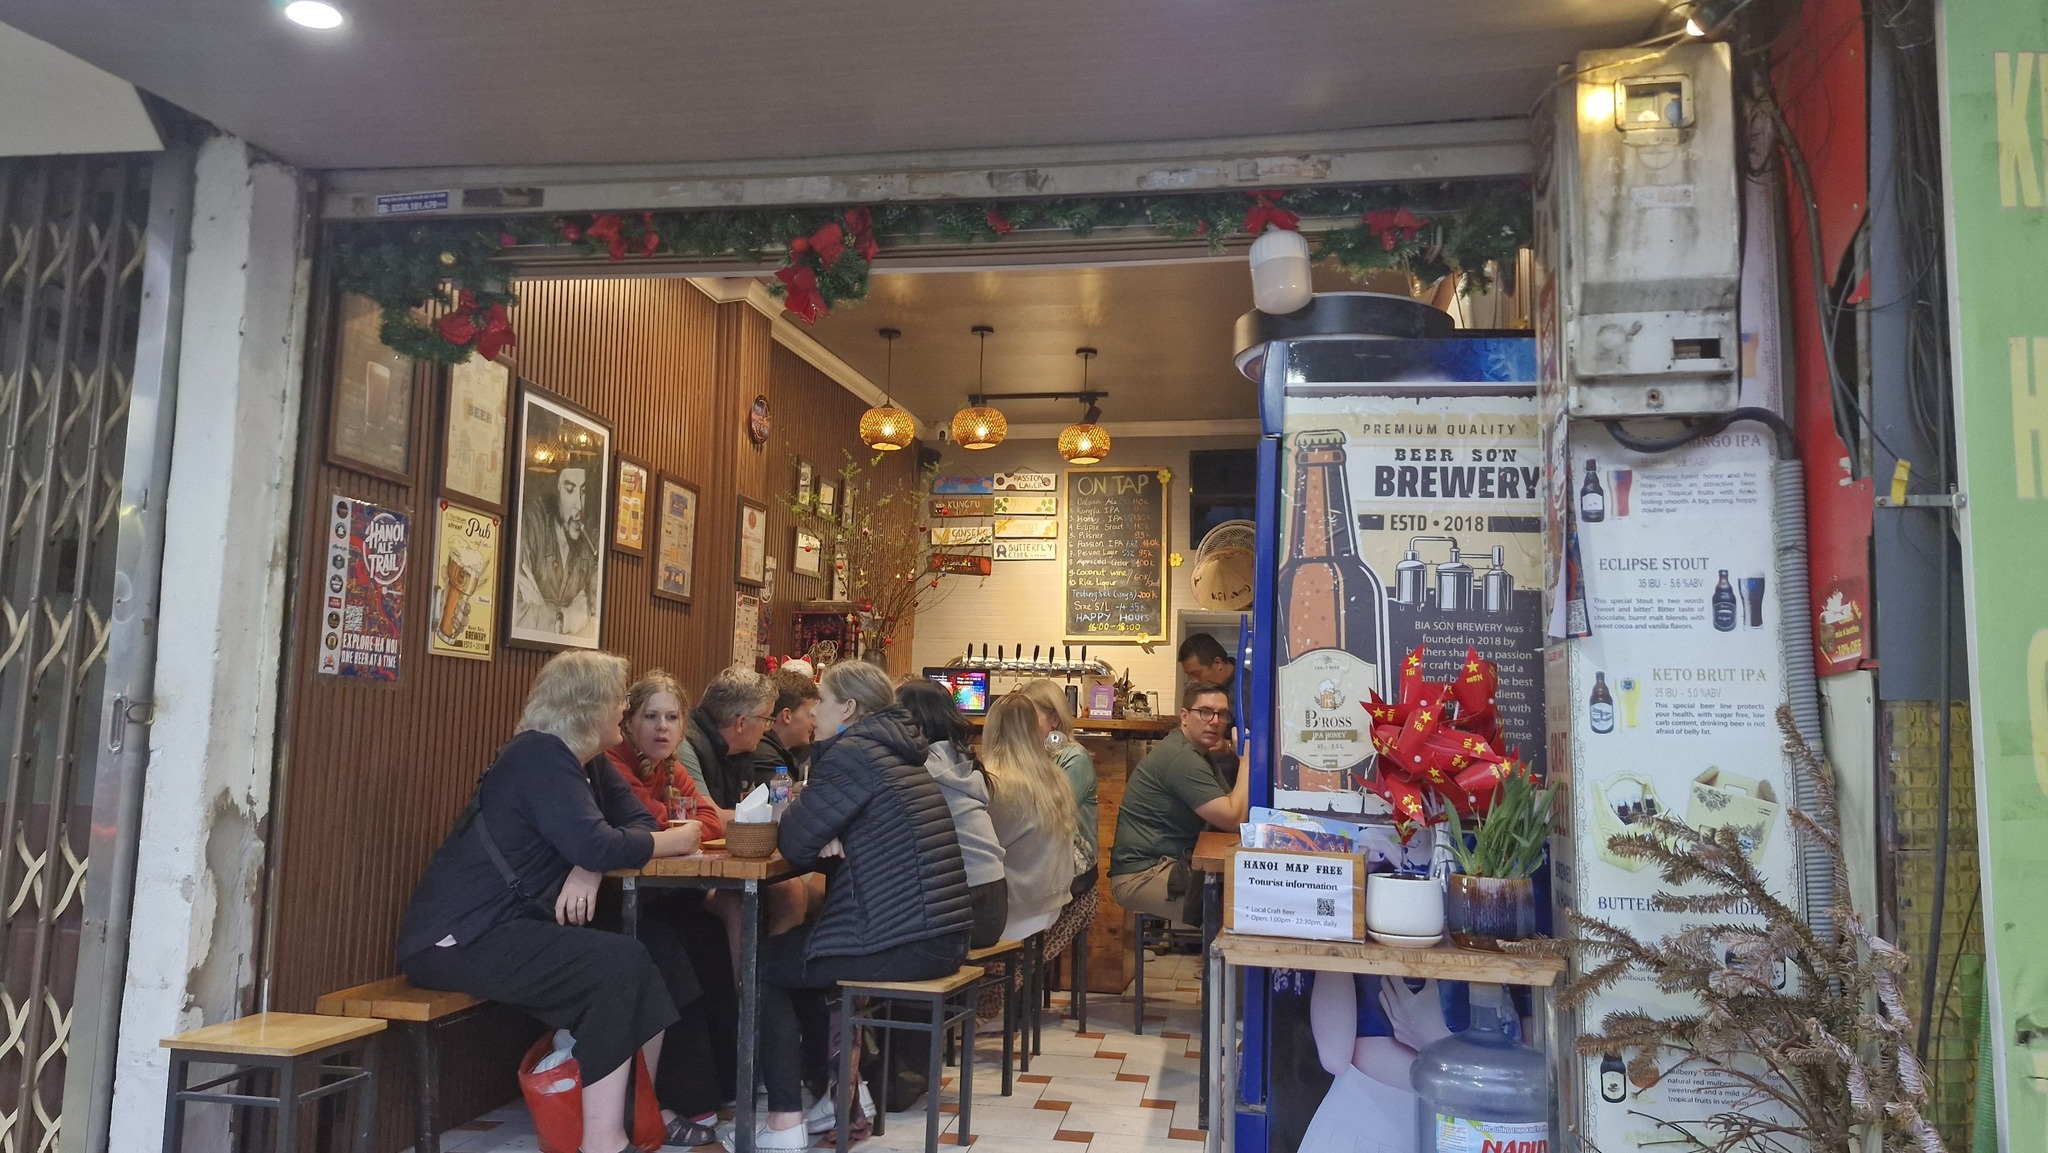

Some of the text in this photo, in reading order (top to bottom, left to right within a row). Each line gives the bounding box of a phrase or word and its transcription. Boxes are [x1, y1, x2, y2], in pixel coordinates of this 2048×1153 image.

[1363, 424, 1516, 436] PREMIUM QUALITY
[1736, 434, 1763, 448] IPA
[1395, 448, 1454, 462] BEER
[1078, 474, 1149, 496] ON TAP
[1374, 465, 1541, 499] BREWERY
[1108, 515, 1124, 523] IPA
[1390, 515, 1484, 531] ESTD 2018
[466, 517, 491, 540] Pub
[377, 541, 394, 554] ALE
[1008, 543, 1053, 552] BUTTERFLY
[1078, 540, 1104, 548] Passion
[368, 553, 400, 579] TRAIL
[1600, 557, 1710, 571] ECLIPSE STOUT
[1076, 568, 1128, 577] Coconut wine
[1079, 577, 1094, 586] Rice
[1610, 597, 1632, 605] special
[1076, 613, 1111, 622] HAPPY
[1415, 621, 1524, 633] BIA SON BREWERY was
[342, 632, 374, 652] EXPLORE
[1422, 634, 1516, 648] founded in 2018 by
[341, 650, 353, 664] ONE
[354, 651, 369, 665] BEER
[1486, 652, 1493, 660] a
[1494, 653, 1533, 664] passion
[1430, 661, 1451, 671] craft
[1517, 668, 1524, 676] a
[1652, 667, 1767, 681] KETO BRUT IPA
[1438, 674, 1534, 688] of best
[1510, 704, 1532, 713] with
[1672, 702, 1696, 711] special
[1737, 702, 1766, 711] protects
[1514, 718, 1525, 727] to
[1655, 712, 1670, 720] your
[1714, 713, 1733, 721] sugar
[1700, 719, 1730, 728] drinking
[1686, 728, 1702, 736] belly
[1243, 860, 1343, 876] HANOI MAP FREE
[1285, 879, 1339, 891] information
[1323, 919, 1338, 928] daily
[1667, 1077, 1706, 1088] natural red
[1703, 1088, 1717, 1096] and
[1724, 1088, 1740, 1097] mild
[1667, 1095, 1721, 1105] tropical fruits in
